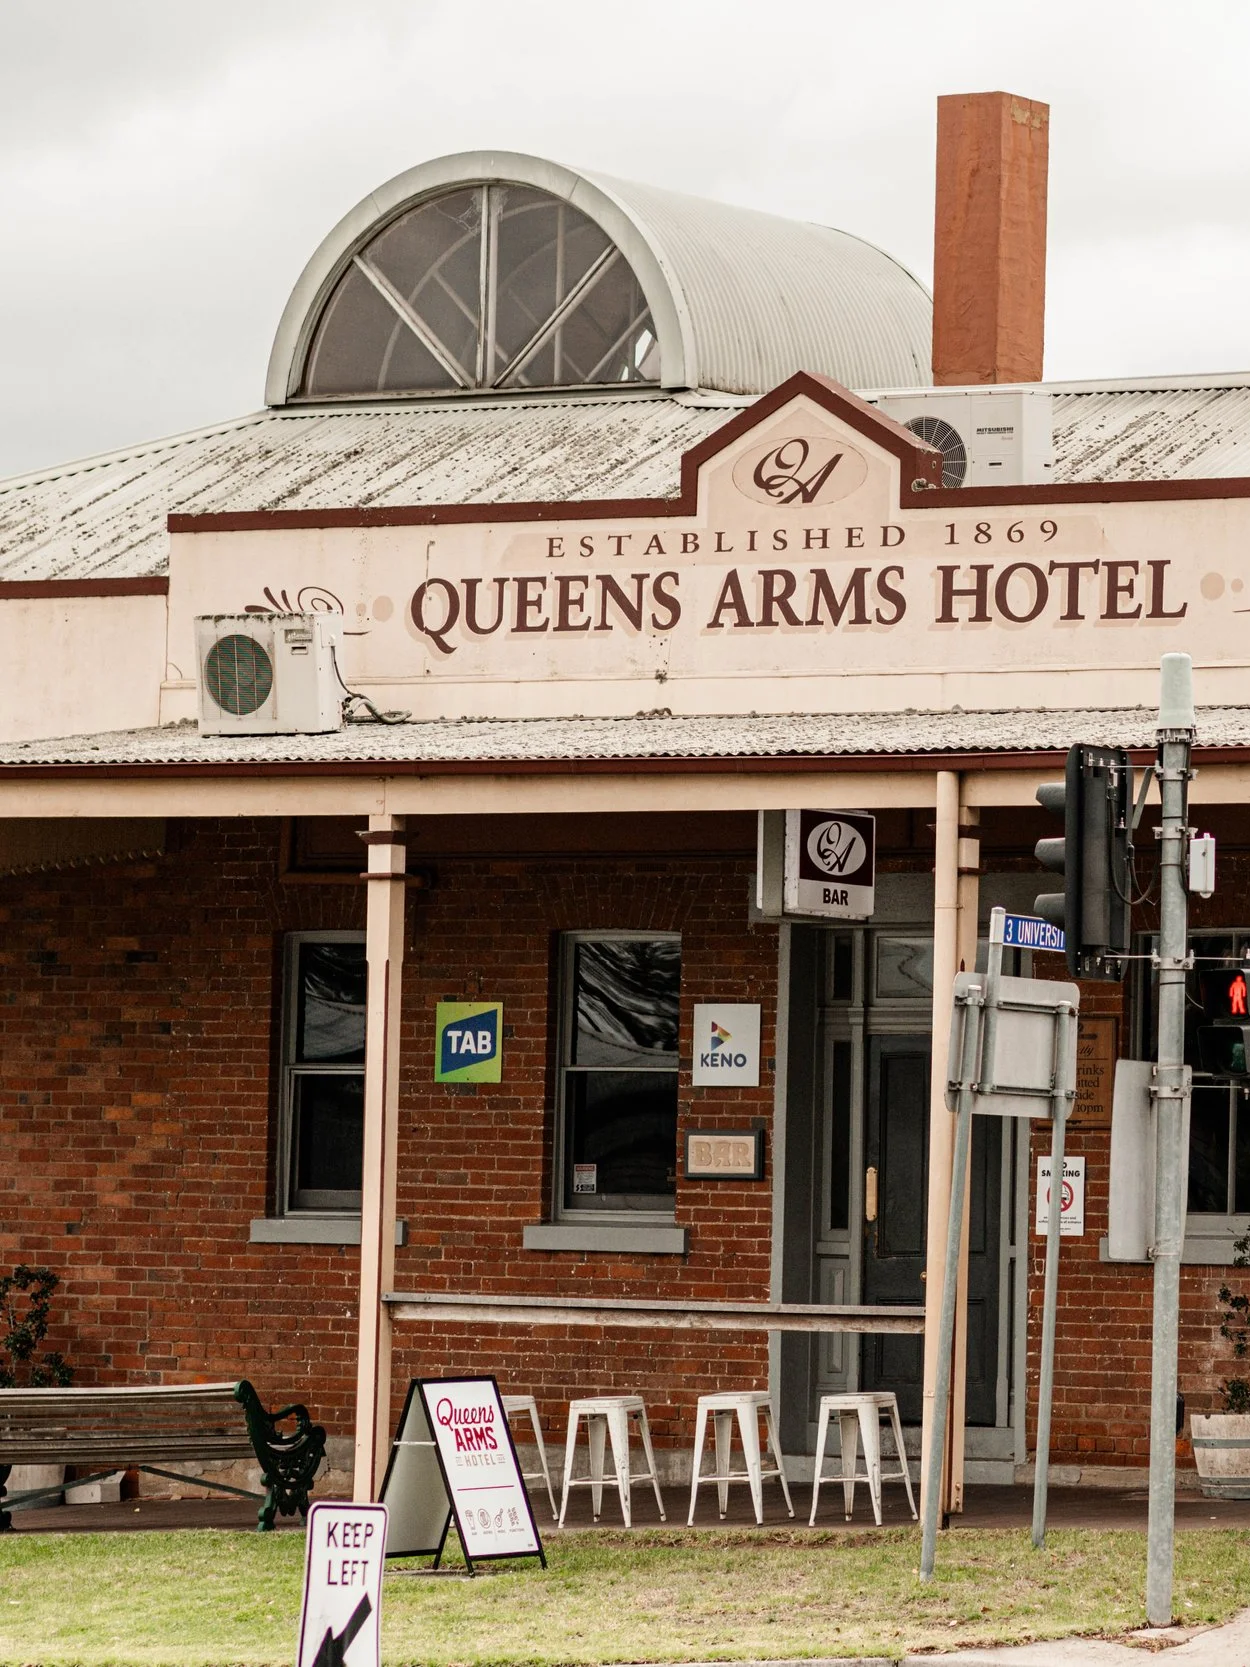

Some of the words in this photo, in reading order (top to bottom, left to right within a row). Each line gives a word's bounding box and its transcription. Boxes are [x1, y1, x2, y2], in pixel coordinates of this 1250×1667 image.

[545, 524, 907, 559] ESTABLISHED
[944, 518, 1059, 546] 1869
[411, 570, 682, 653] QUEENS
[706, 565, 907, 629] ARMS
[936, 559, 1188, 624] HOTEL
[822, 888, 849, 906] BAR
[447, 1030, 492, 1054] TAB
[700, 1053, 747, 1068] KENO
[1076, 1063, 1105, 1076] rinks
[693, 1140, 752, 1168] BAR
[1041, 1169, 1081, 1178] SMKING
[436, 1397, 495, 1431] Queens
[454, 1426, 498, 1452] ARMS
[464, 1453, 497, 1467] HOTEL
[327, 1521, 374, 1548] KEEP
[327, 1559, 369, 1586] LEFT
